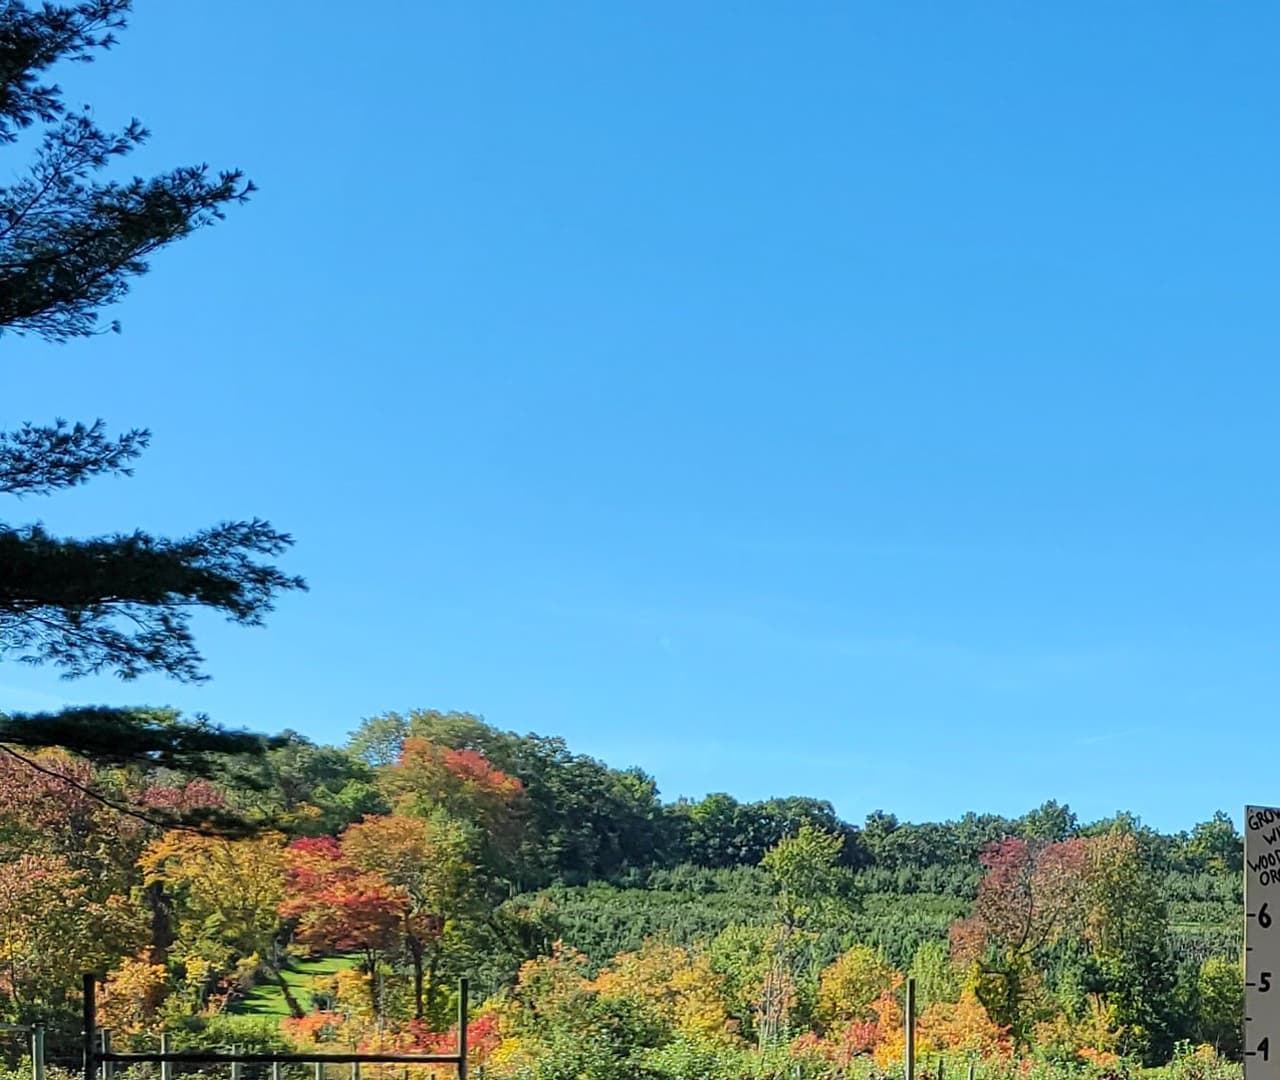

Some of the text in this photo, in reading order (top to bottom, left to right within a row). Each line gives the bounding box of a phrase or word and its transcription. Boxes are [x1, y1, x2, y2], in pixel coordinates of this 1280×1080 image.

[1258, 902, 1272, 929] 6
[1258, 972, 1272, 993] 5
[1256, 1036, 1270, 1062] 4
